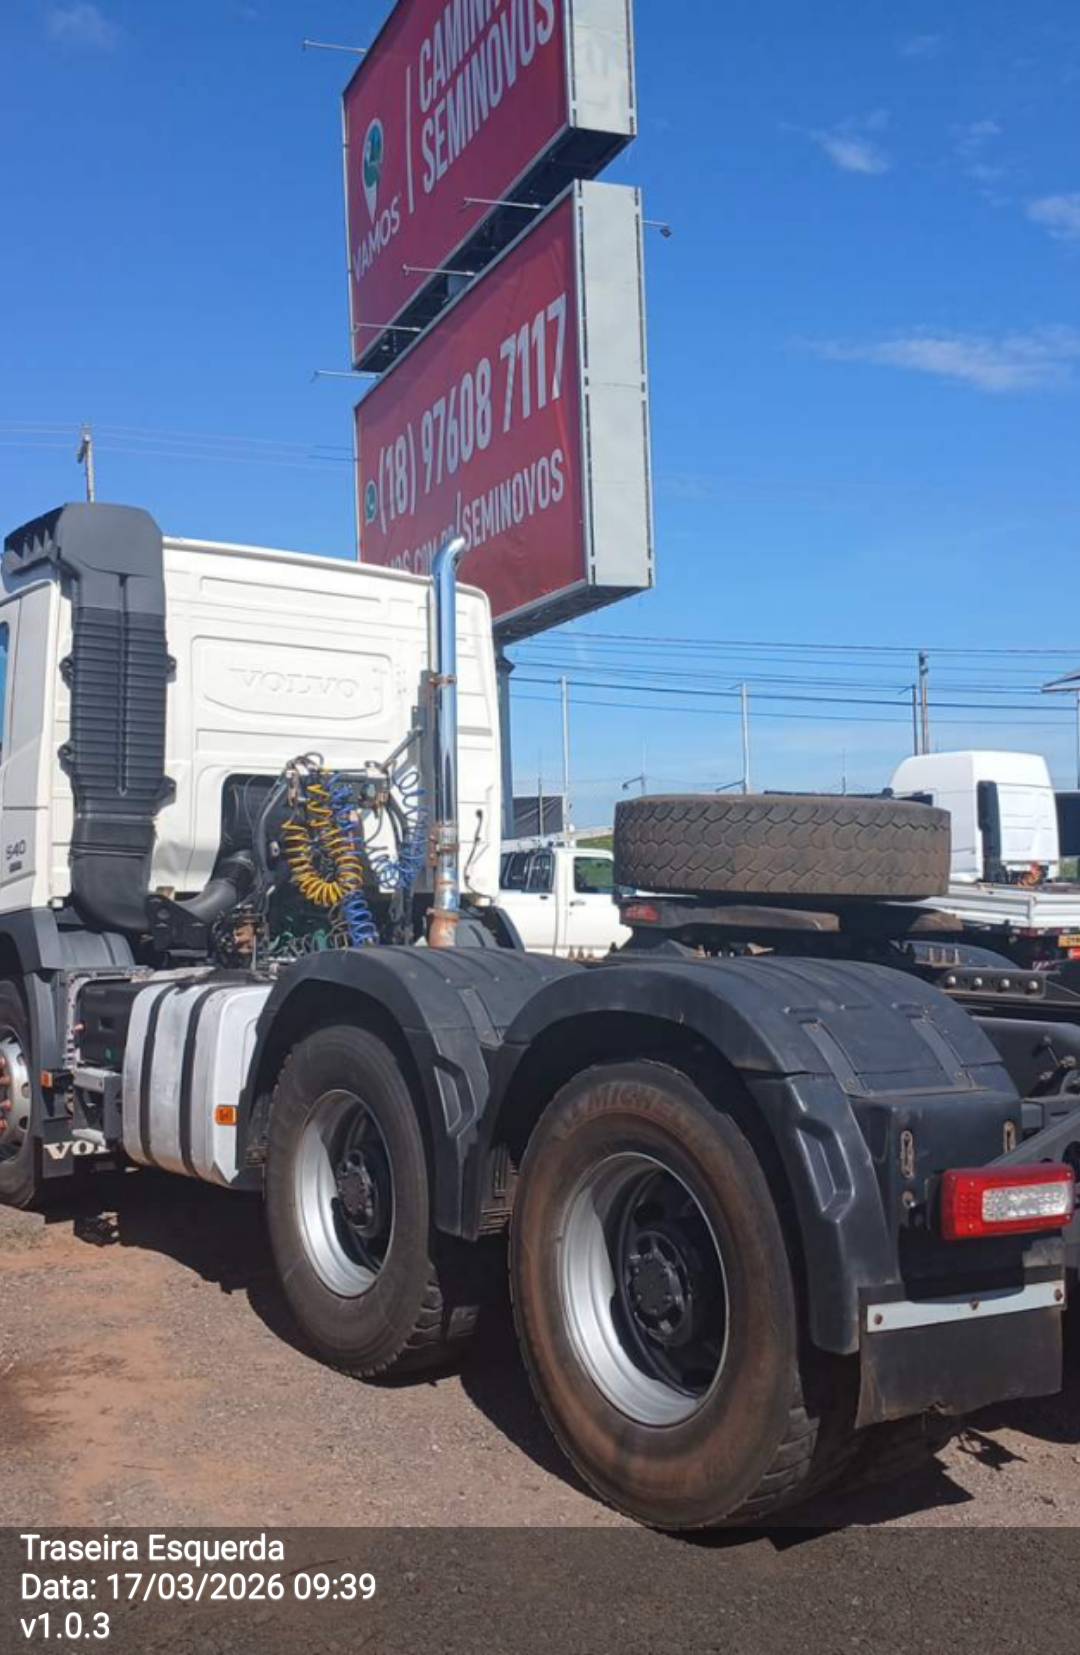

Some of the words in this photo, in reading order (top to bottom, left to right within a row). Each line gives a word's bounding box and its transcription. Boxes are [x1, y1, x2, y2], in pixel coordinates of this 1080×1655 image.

[419, 0, 500, 113] CAMI
[352, 195, 400, 283] VAMOS
[379, 423, 416, 534] (18)
[422, 358, 492, 493] 97608
[500, 293, 567, 432] 7117
[228, 667, 359, 698] VOLVO
